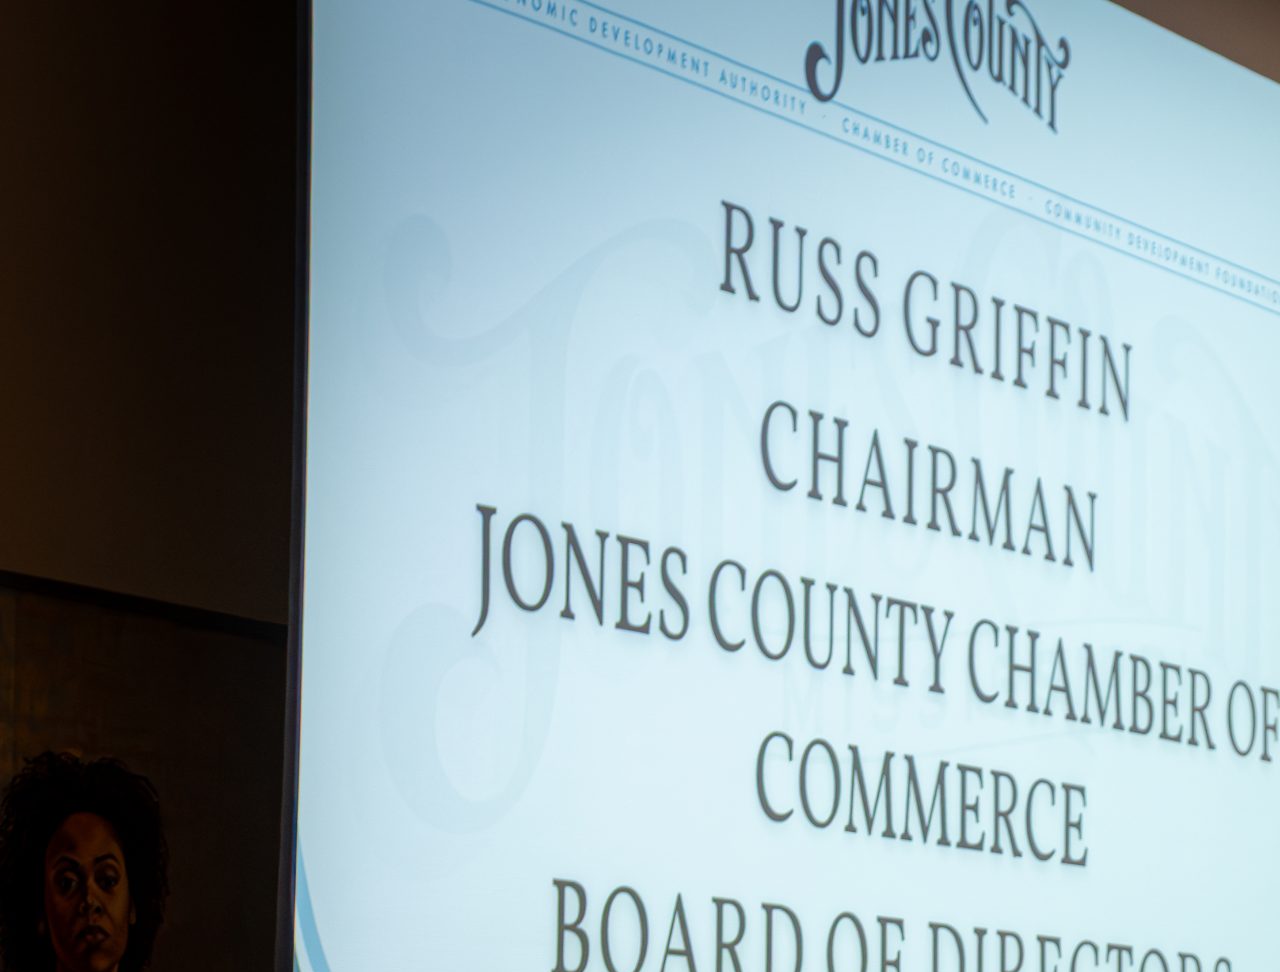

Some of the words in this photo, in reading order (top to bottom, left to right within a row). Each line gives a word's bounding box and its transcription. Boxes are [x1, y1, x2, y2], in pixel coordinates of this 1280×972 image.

[589, 16, 710, 77] DEVELOPMENT
[718, 69, 807, 116] AUTHORITY
[841, 116, 908, 156] CHAMBER
[916, 147, 934, 165] OF
[941, 157, 1016, 199] COMMERCE
[1044, 199, 1121, 241] COMMUNITY
[1127, 231, 1210, 275] DEVELOPMENT
[719, 200, 880, 338] RUSS
[903, 271, 1131, 420] GRIFFIN
[760, 401, 1097, 572] CHAIRMAN
[471, 503, 690, 641] JONES
[708, 560, 955, 694] COUNTY
[968, 620, 1215, 750] CHAMBER
[1227, 681, 1280, 762] OF
[756, 732, 1088, 867] COMMERCE
